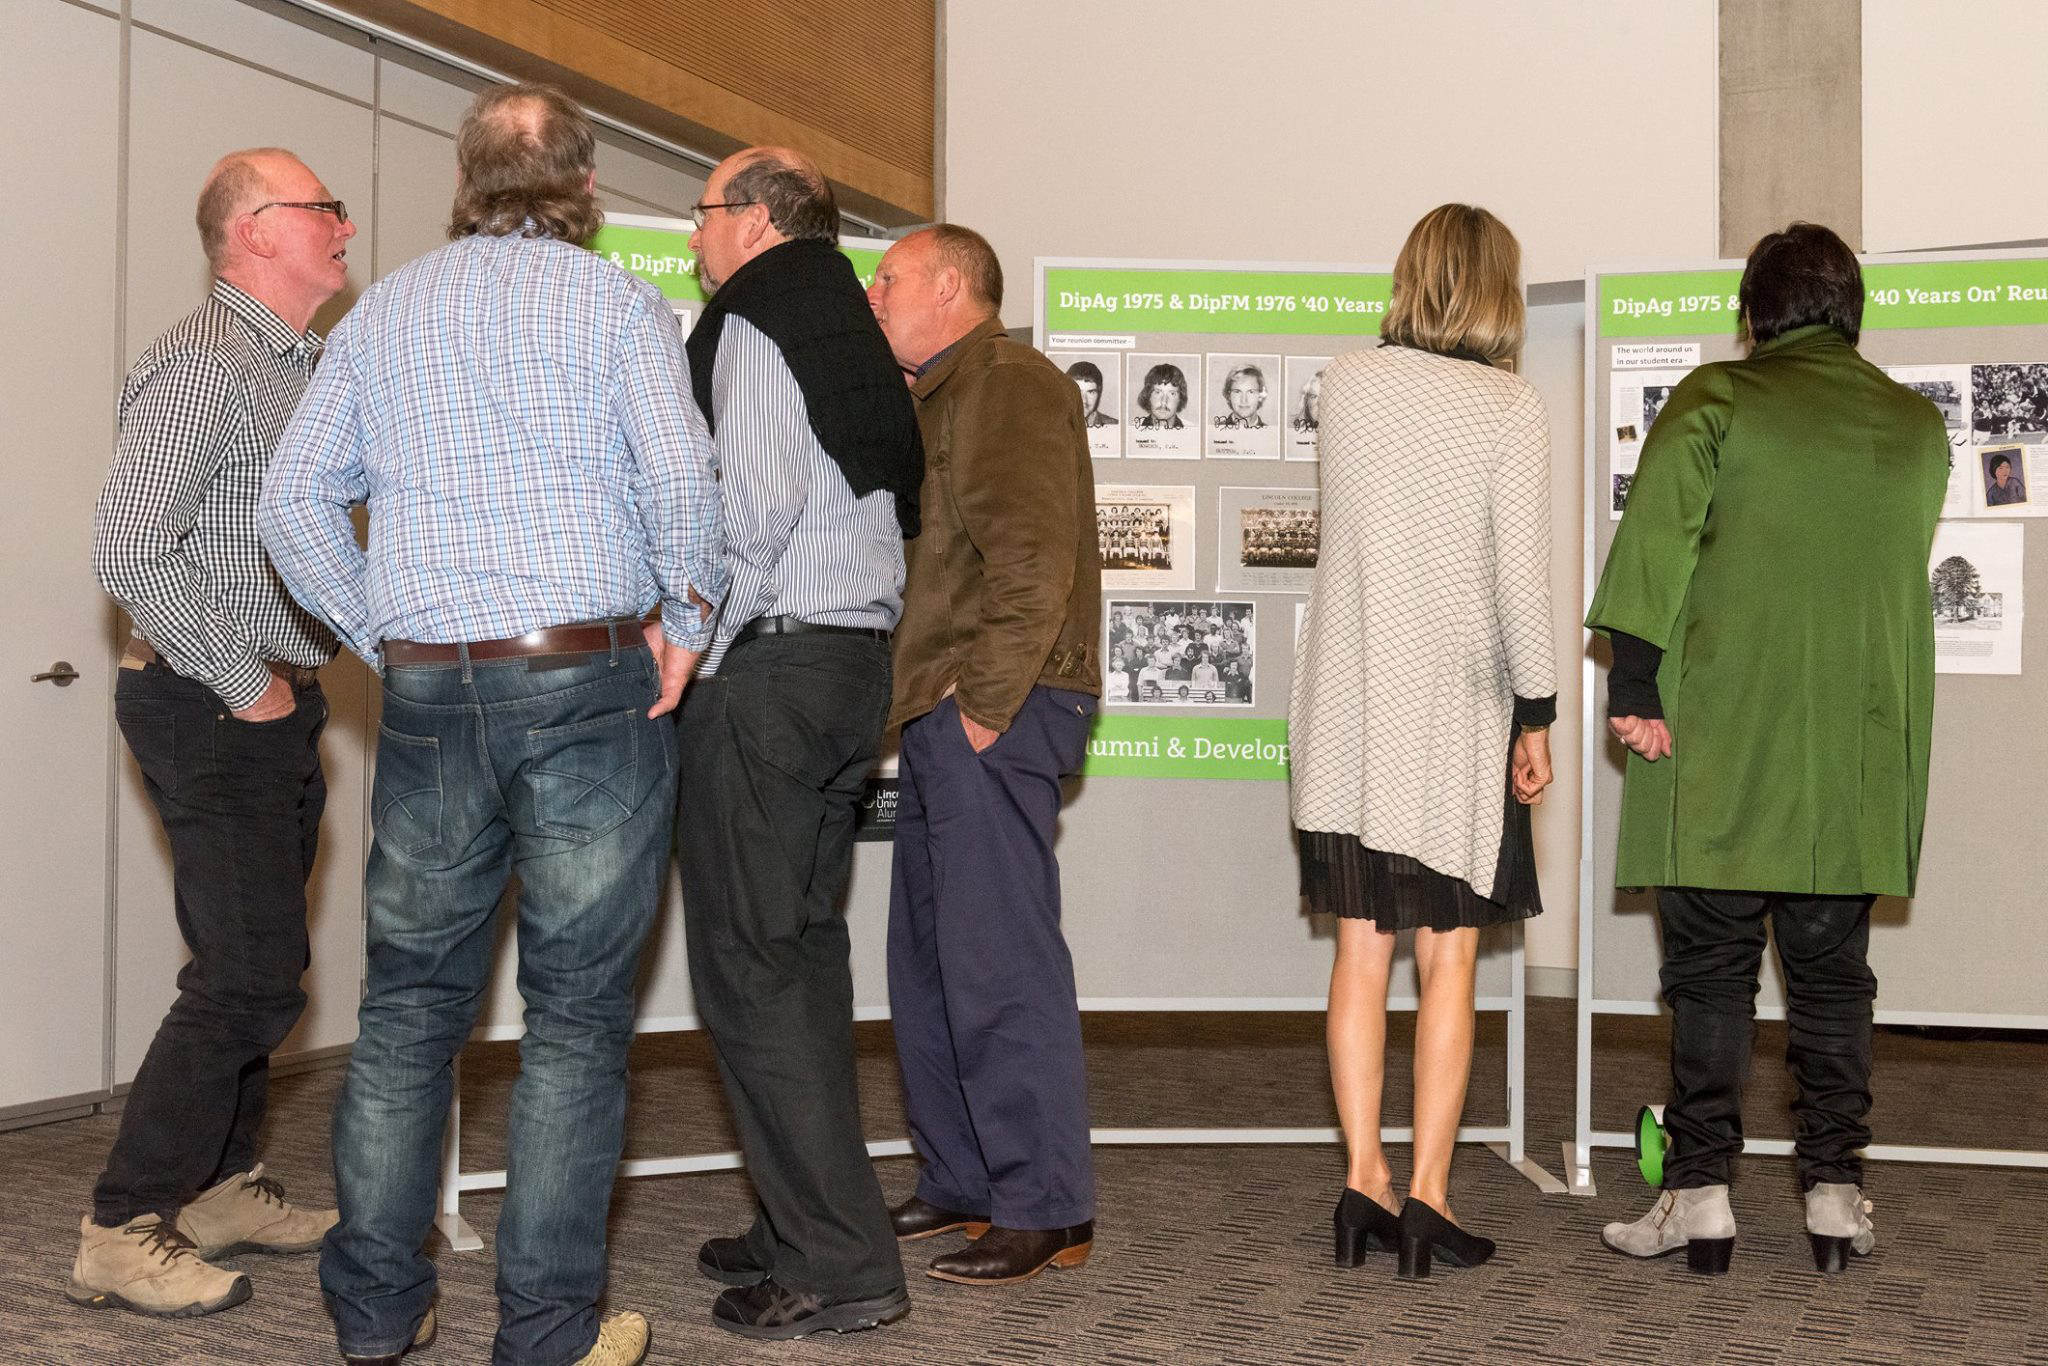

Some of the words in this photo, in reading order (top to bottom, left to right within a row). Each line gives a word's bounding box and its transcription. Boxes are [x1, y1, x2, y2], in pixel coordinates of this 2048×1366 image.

[630, 253, 696, 277] DipFM
[1059, 292, 1118, 312] DipAg
[1122, 293, 1164, 309] 1975
[1169, 294, 1184, 310] &
[1188, 294, 1250, 314] DipFM
[1255, 296, 1296, 312] 1976
[1301, 296, 1329, 312] ‘40
[1334, 297, 1384, 313] Years
[1612, 297, 1673, 317] DipAg
[1679, 295, 1721, 312] 1975
[1726, 294, 1741, 311] &
[1869, 289, 1900, 305] ‘40
[1905, 288, 1961, 305] Years
[1967, 285, 2002, 303] On’
[2007, 284, 2048, 302] Reu
[1617, 346, 1630, 354] The
[1632, 346, 1654, 354] world
[1167, 736, 1186, 759] &
[1193, 737, 1290, 766] Develop
